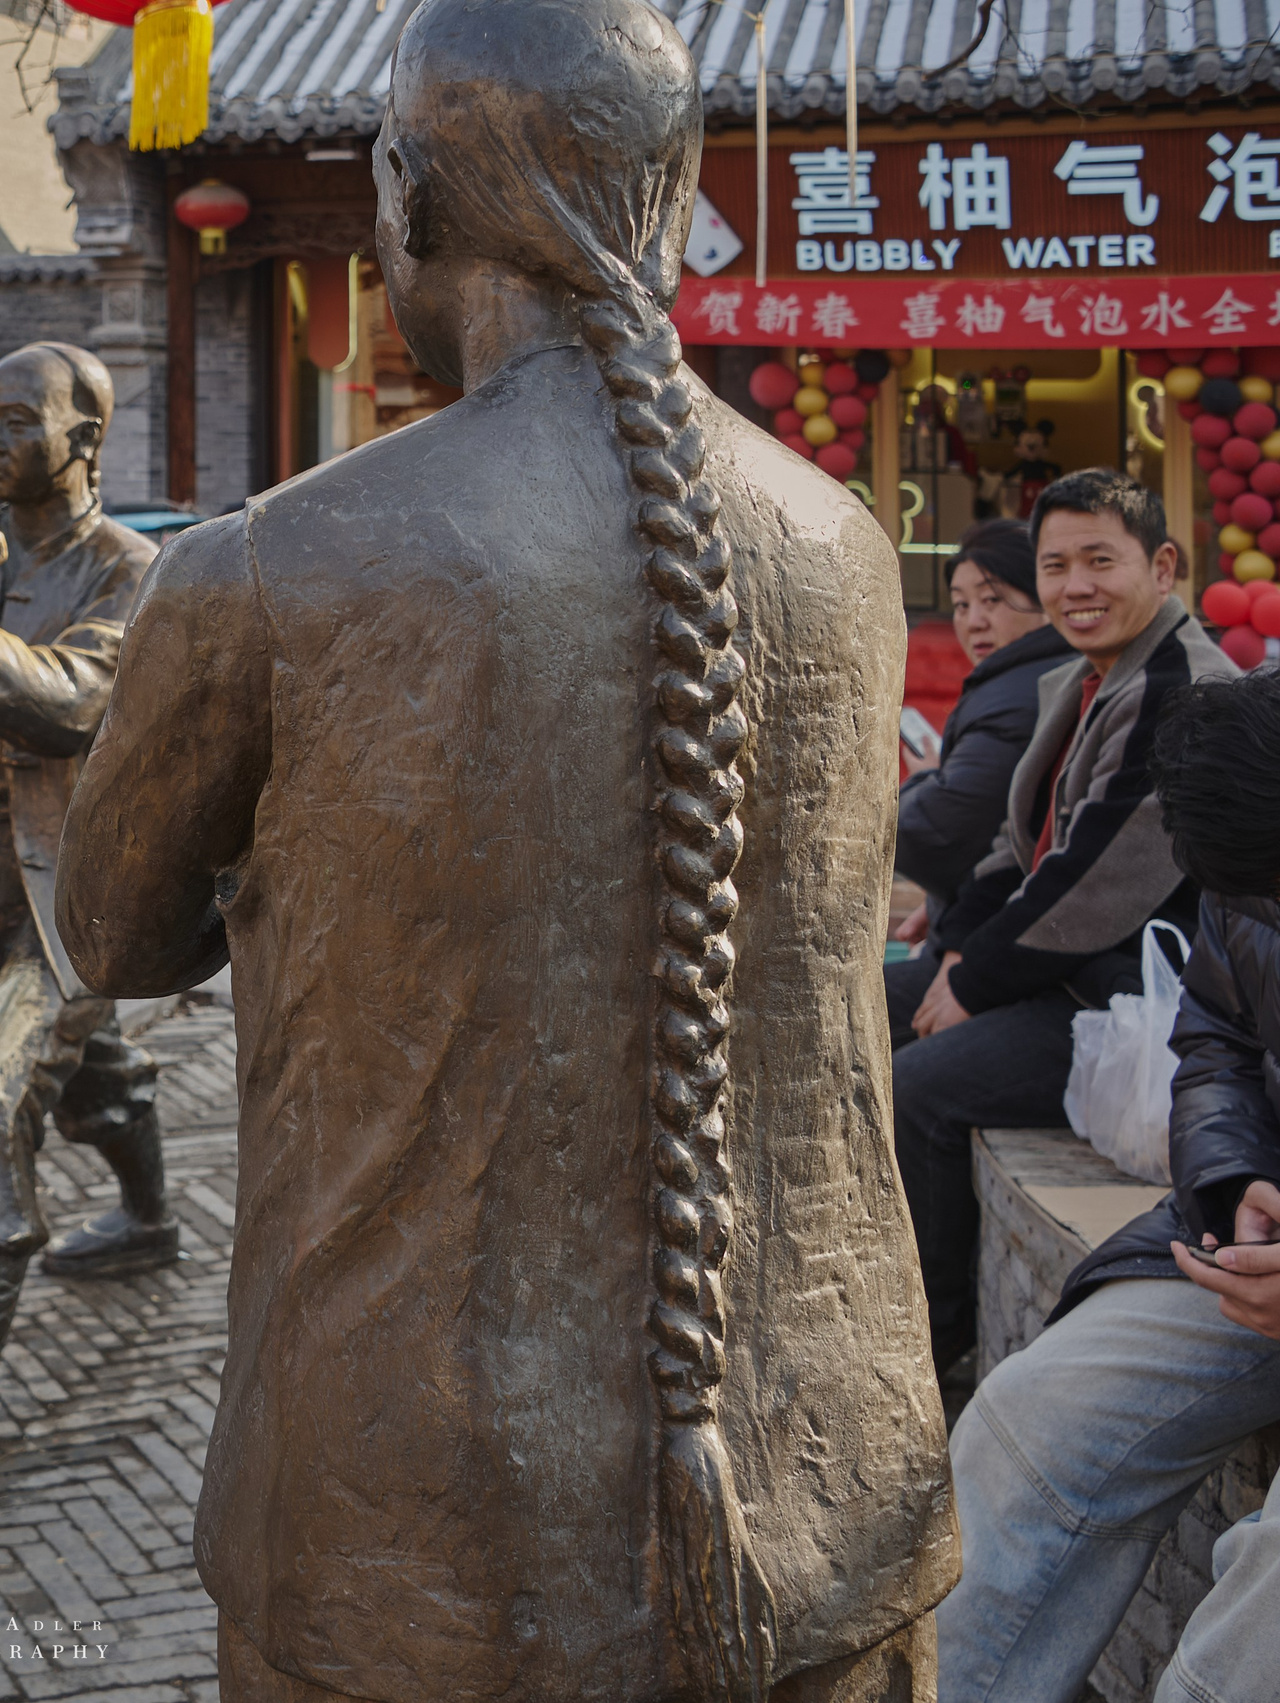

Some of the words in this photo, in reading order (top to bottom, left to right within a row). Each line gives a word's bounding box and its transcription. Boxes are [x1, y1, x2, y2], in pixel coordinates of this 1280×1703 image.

[796, 238, 961, 272] BUBBLY
[1002, 234, 1157, 269] WATER
[692, 289, 860, 339] 贺新春
